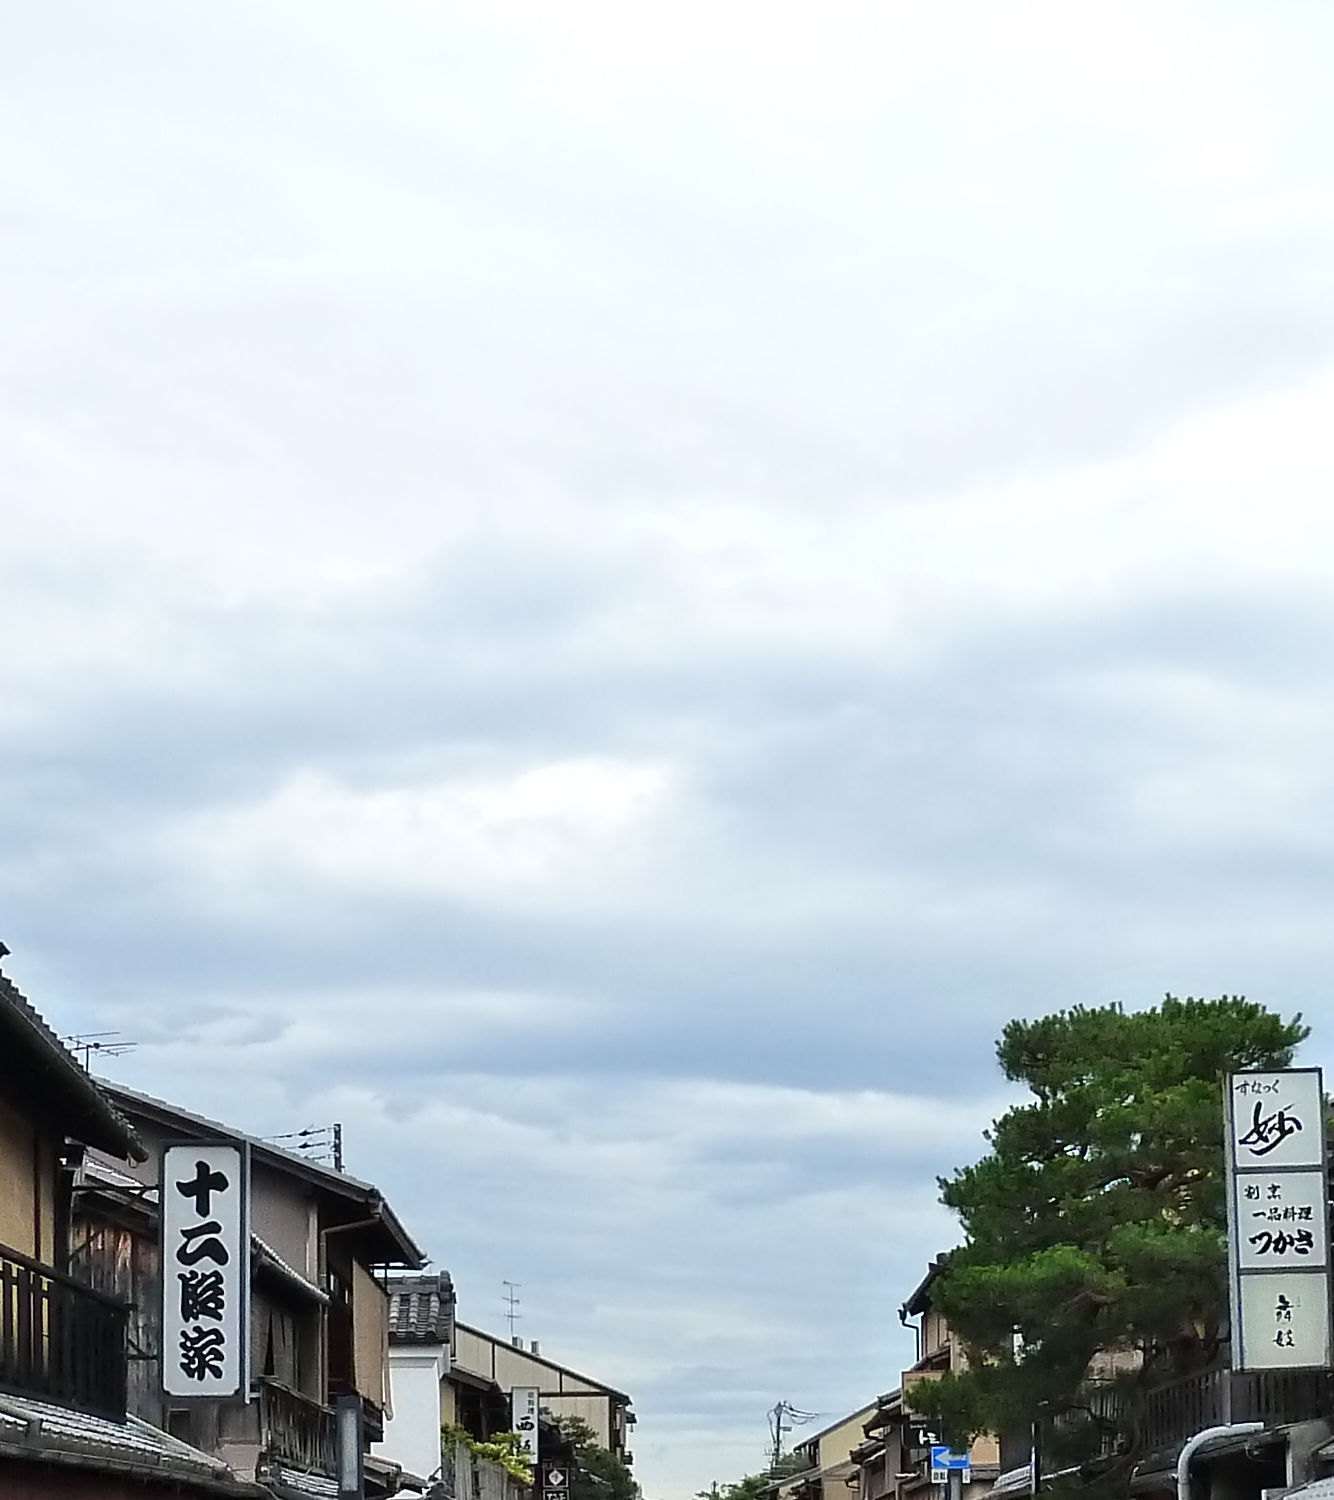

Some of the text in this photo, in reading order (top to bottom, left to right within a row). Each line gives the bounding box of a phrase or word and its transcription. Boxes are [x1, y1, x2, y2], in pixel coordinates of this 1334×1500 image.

[1234, 1079, 1280, 1096] すなっく
[1252, 1206, 1313, 1222] 一品料理
[1248, 1228, 1314, 1254] つかさ
[175, 1160, 230, 1382] 十二段家
